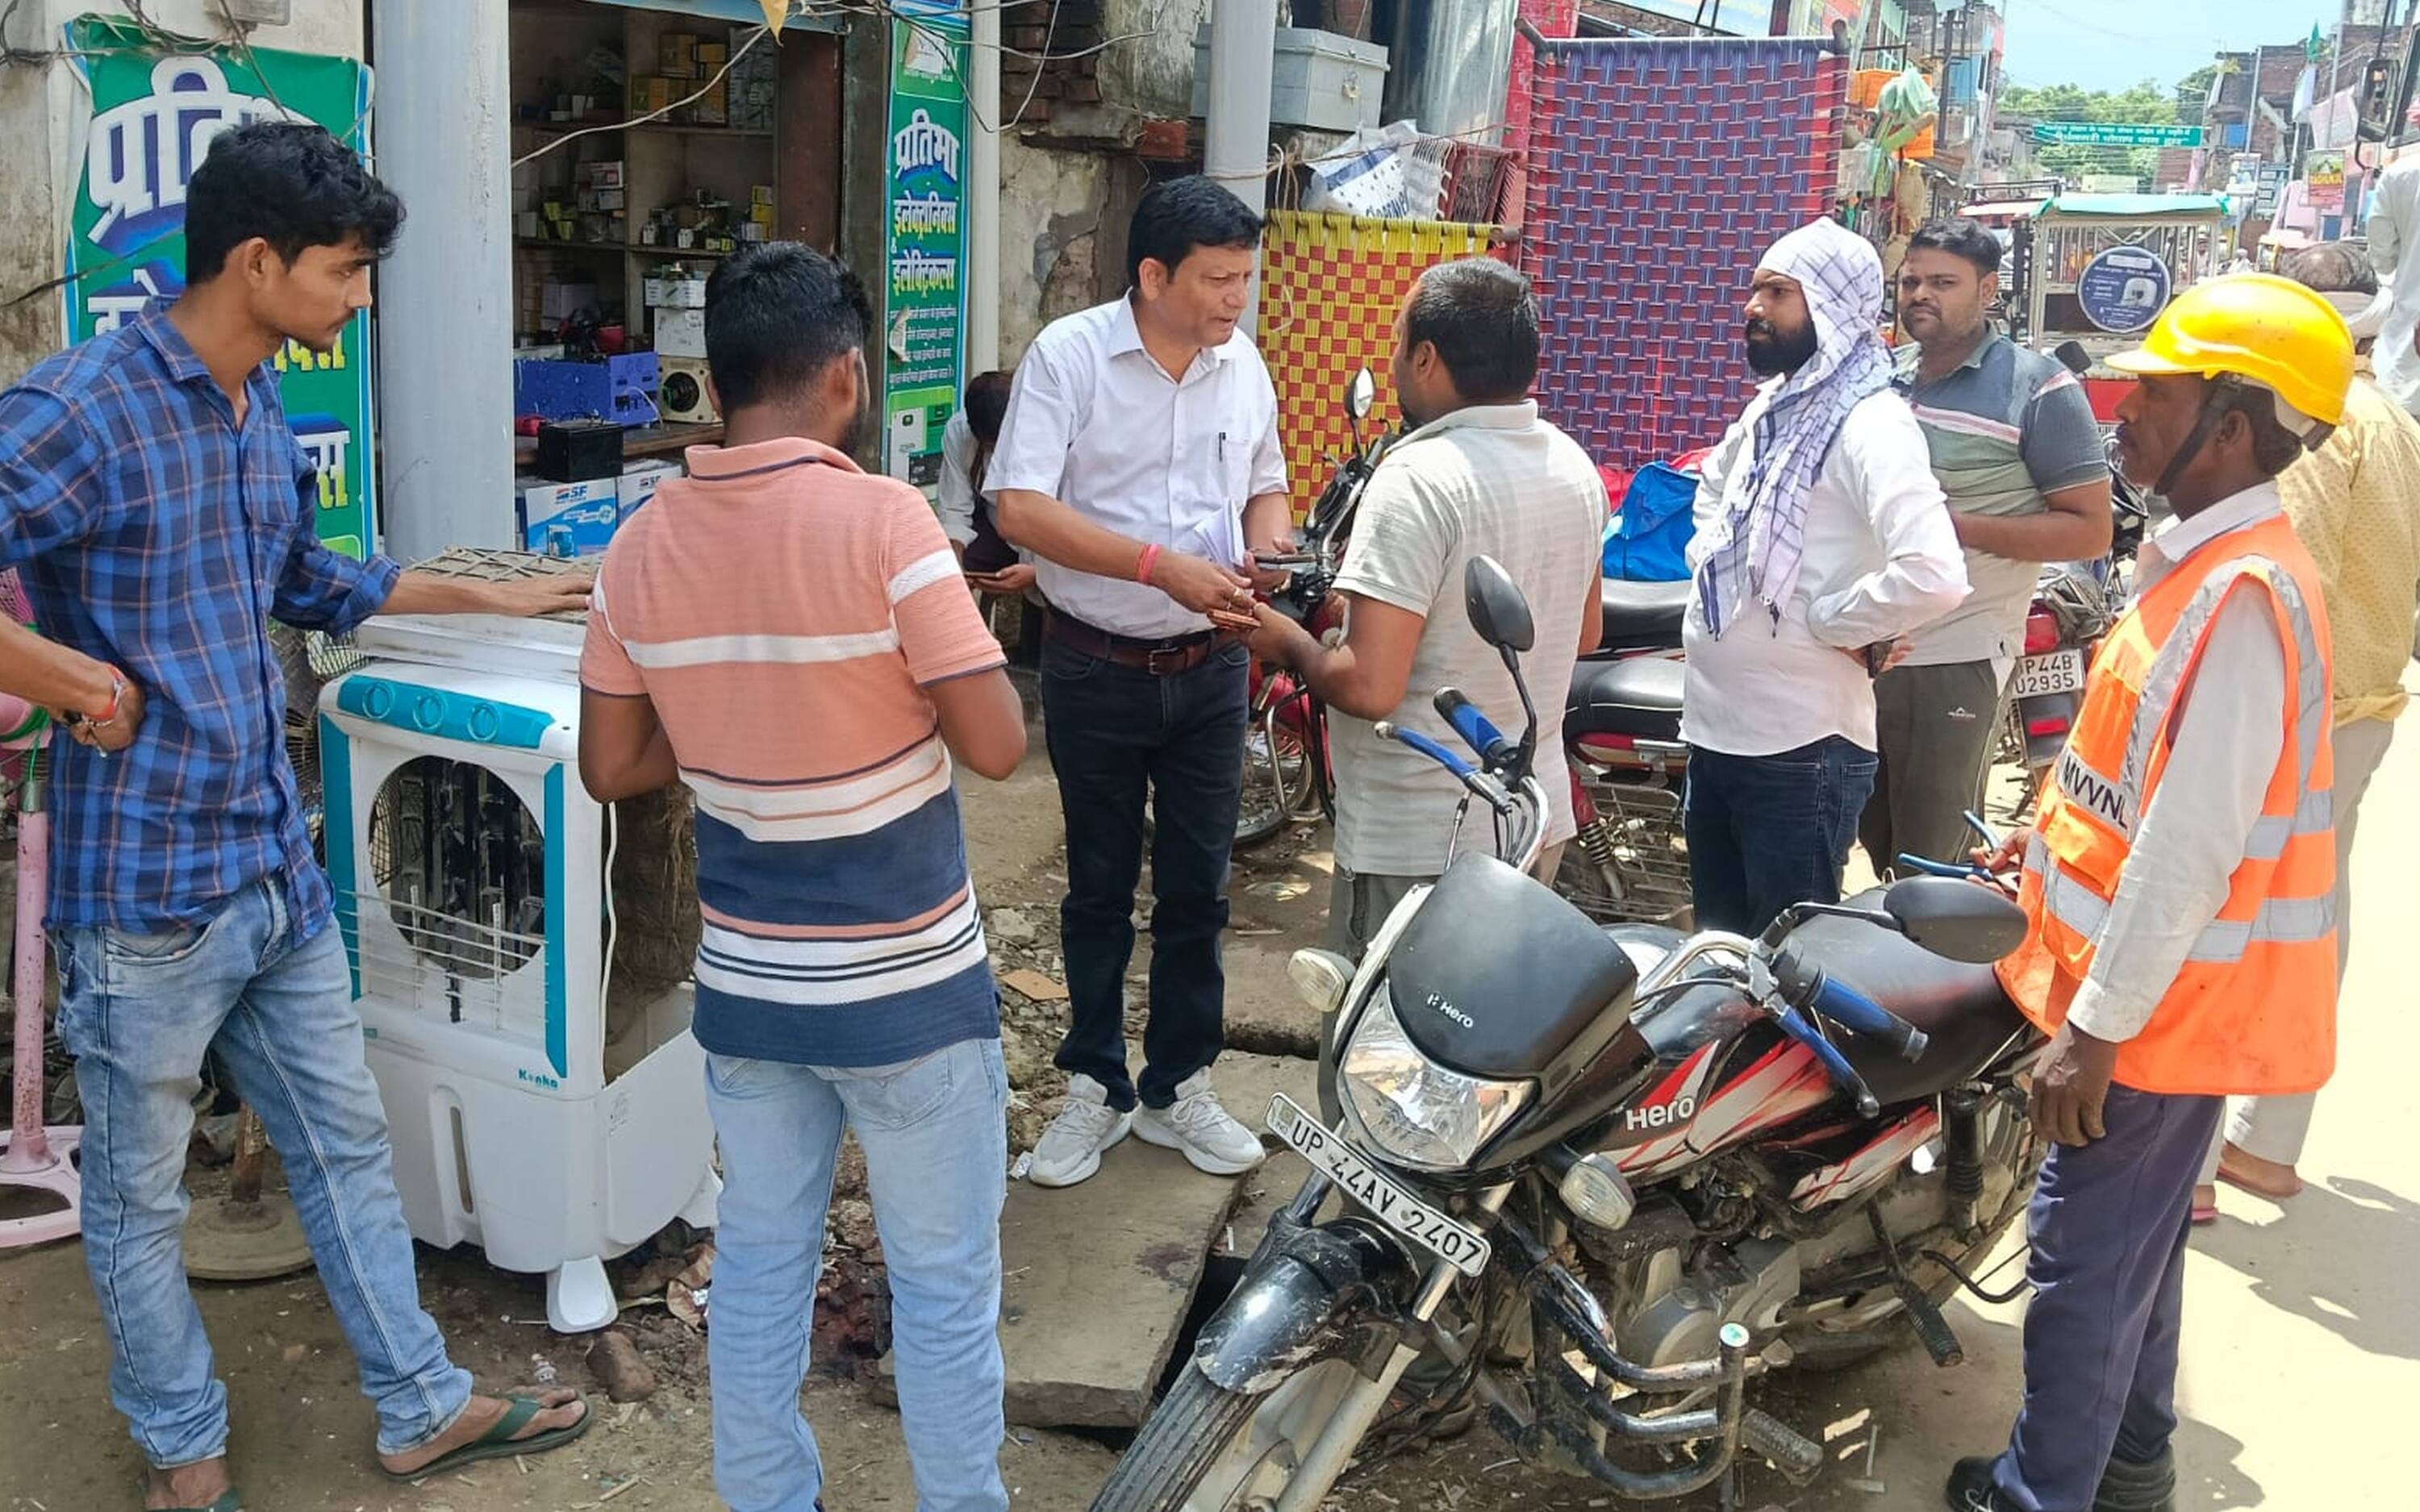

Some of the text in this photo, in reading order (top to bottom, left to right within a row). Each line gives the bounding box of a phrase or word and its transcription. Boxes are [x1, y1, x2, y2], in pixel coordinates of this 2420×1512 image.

[894, 108, 960, 181] प्रतिभा
[2019, 655, 2072, 674] P44B
[2015, 673, 2074, 694] U2935
[2064, 756, 2128, 830] MVVNL
[1440, 1001, 1474, 1028] Hero
[1626, 1097, 1694, 1130] Hero
[1292, 1120, 1323, 1153] UP
[1405, 1210, 1481, 1264] 2407
